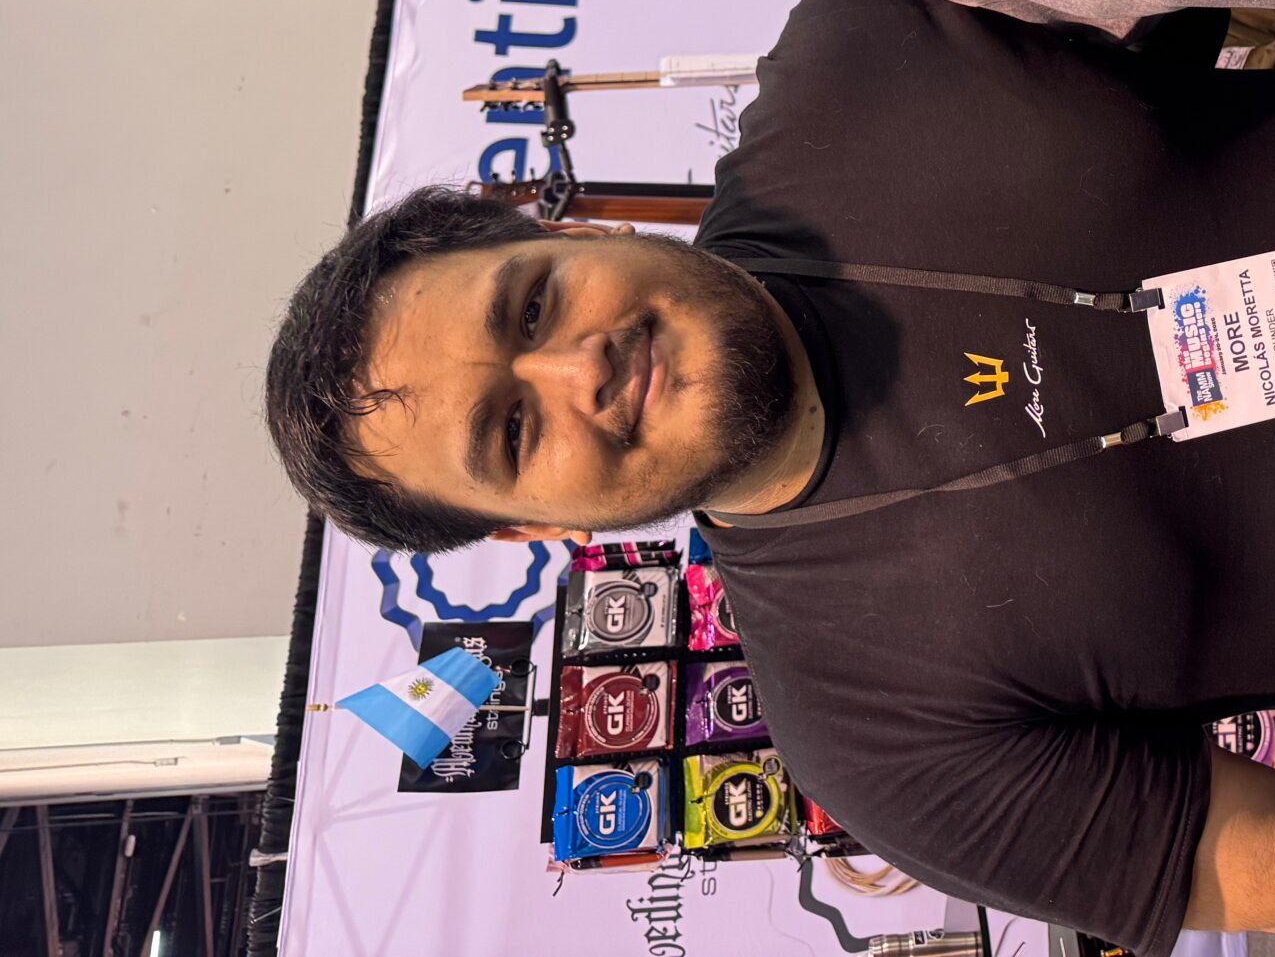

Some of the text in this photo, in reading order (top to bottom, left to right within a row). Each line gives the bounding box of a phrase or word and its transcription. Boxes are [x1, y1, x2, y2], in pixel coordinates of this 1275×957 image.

[1238, 269, 1263, 338] MORETTA
[1023, 318, 1043, 385] Guitars
[1180, 303, 1205, 367] MUSIC
[1193, 301, 1213, 365] begins here
[1224, 311, 1250, 373] MORE
[1182, 350, 1192, 369] the
[1204, 371, 1215, 388] Show
[1217, 351, 1227, 375] January
[1195, 372, 1214, 402] NAMM
[607, 595, 625, 633] GK
[486, 670, 506, 730] stings
[607, 691, 625, 735] GK
[732, 685, 747, 722] GK
[599, 790, 617, 835] GK
[729, 778, 747, 826] GK
